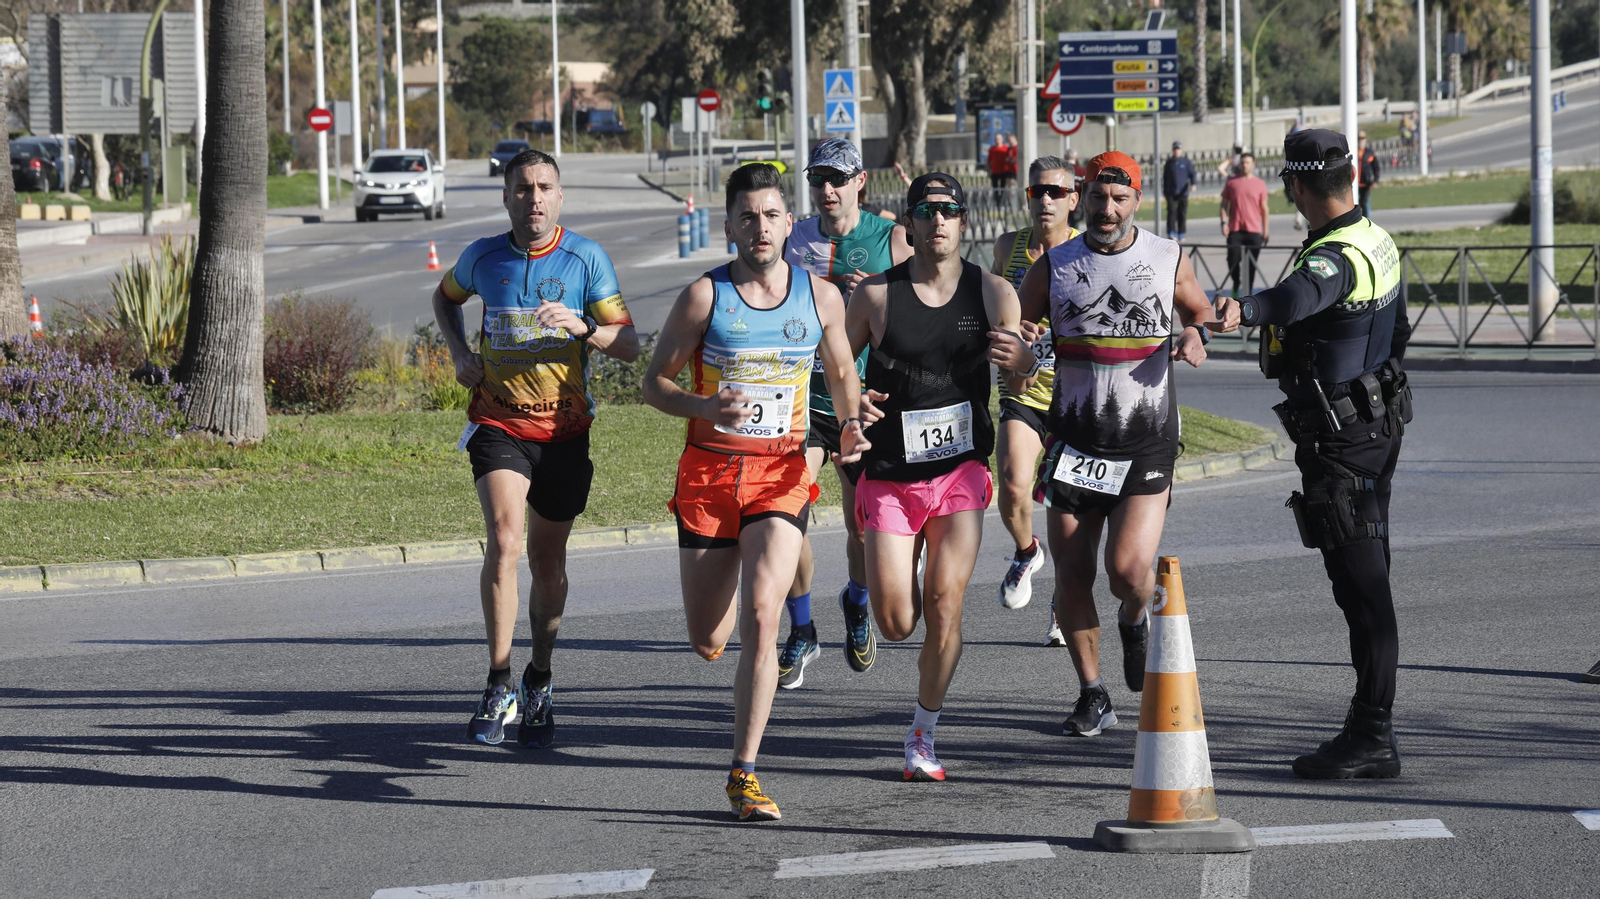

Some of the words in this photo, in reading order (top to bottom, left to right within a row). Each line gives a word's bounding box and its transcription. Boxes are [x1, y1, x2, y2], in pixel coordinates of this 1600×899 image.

[1079, 44, 1107, 54] Centro
[1108, 43, 1139, 53] urbano
[1116, 63, 1140, 71] Ceuta
[1117, 100, 1144, 108] Puerto
[1056, 111, 1076, 123] 30
[1381, 251, 1398, 277] LOCAL
[499, 313, 538, 331] TRAIL
[493, 333, 527, 347] TEAM
[1031, 343, 1054, 360] 32
[501, 355, 532, 364] Gabarras
[534, 357, 539, 365] &
[738, 352, 778, 366] TRAIL
[726, 365, 767, 377] TEAM
[493, 395, 573, 414] Algeciras
[736, 427, 772, 436] EVOS
[920, 425, 955, 449] 134
[925, 447, 959, 460] EVOS
[1071, 455, 1107, 480] 210
[1072, 477, 1105, 491] EVOS
